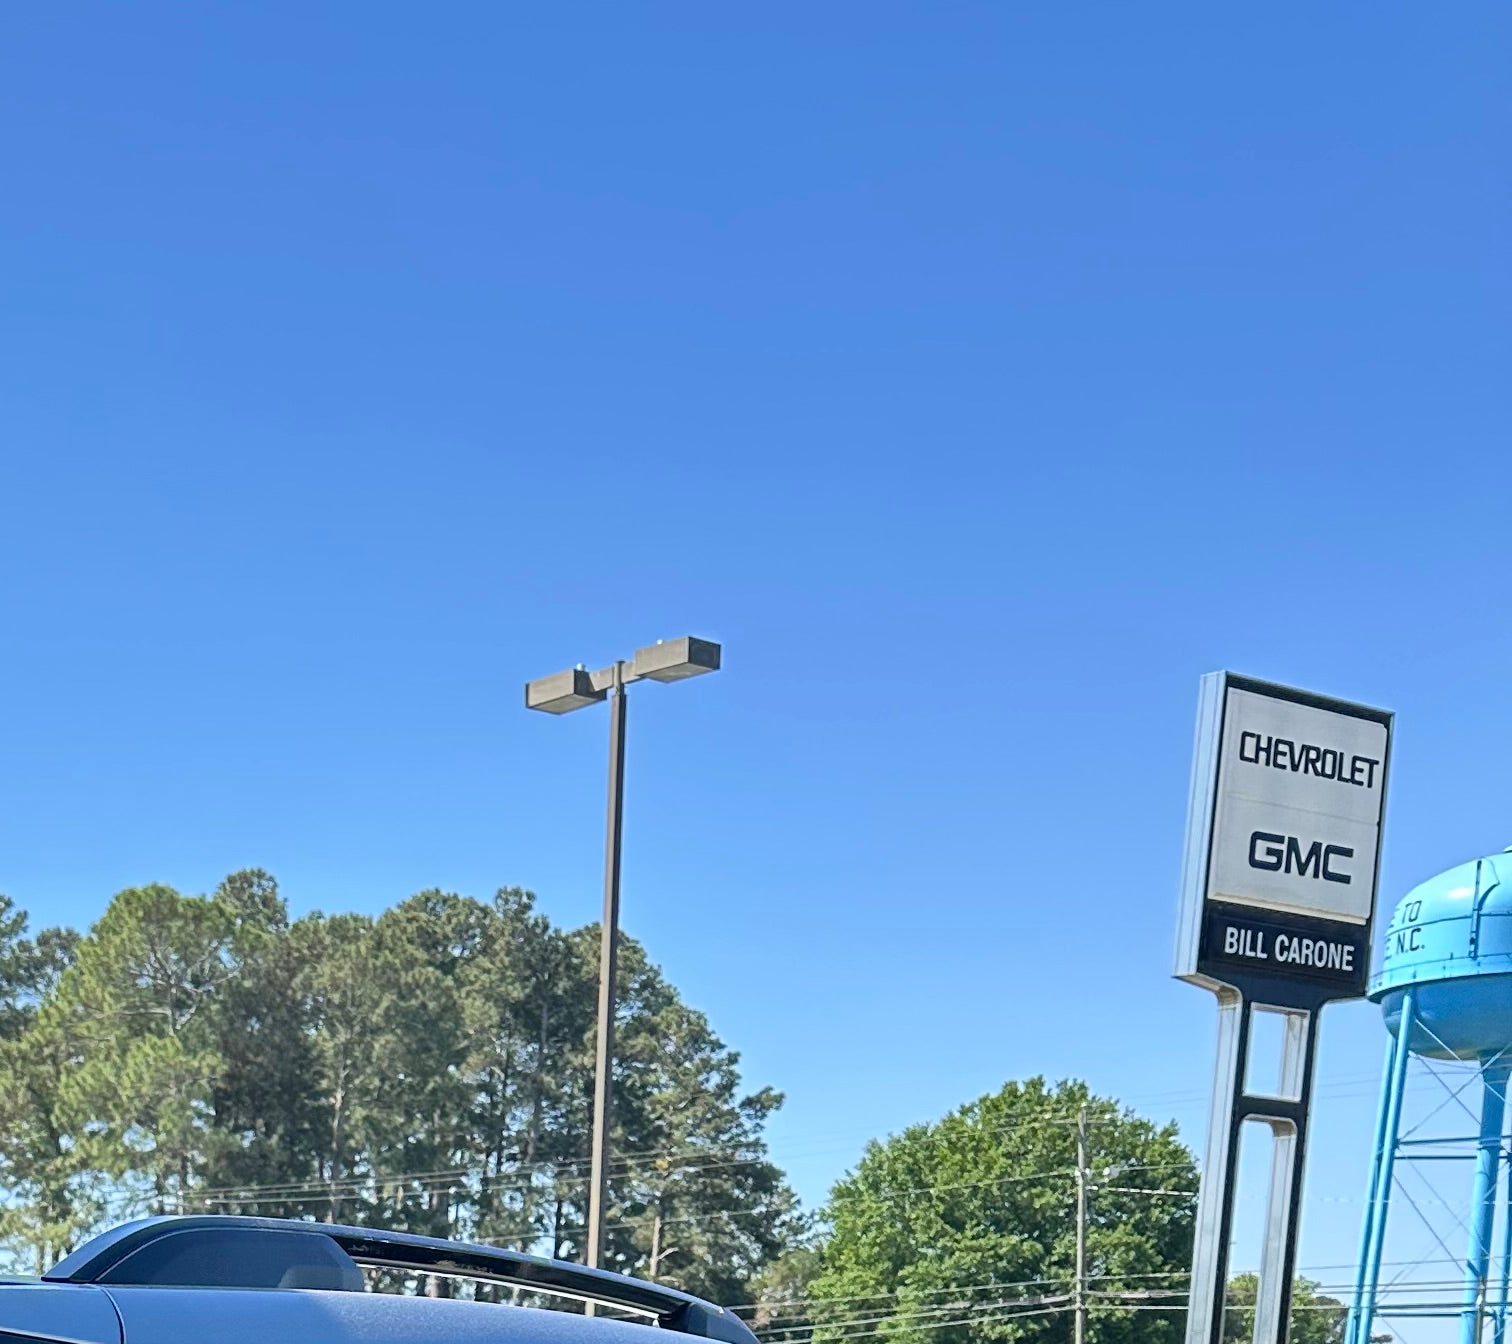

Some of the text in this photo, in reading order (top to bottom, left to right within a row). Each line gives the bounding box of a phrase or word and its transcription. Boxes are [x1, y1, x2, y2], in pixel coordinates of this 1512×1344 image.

[1239, 730, 1380, 789] CHEVROLET
[1248, 830, 1355, 885] GMC
[1224, 926, 1268, 959] BILL
[1274, 934, 1355, 972] CARONE
